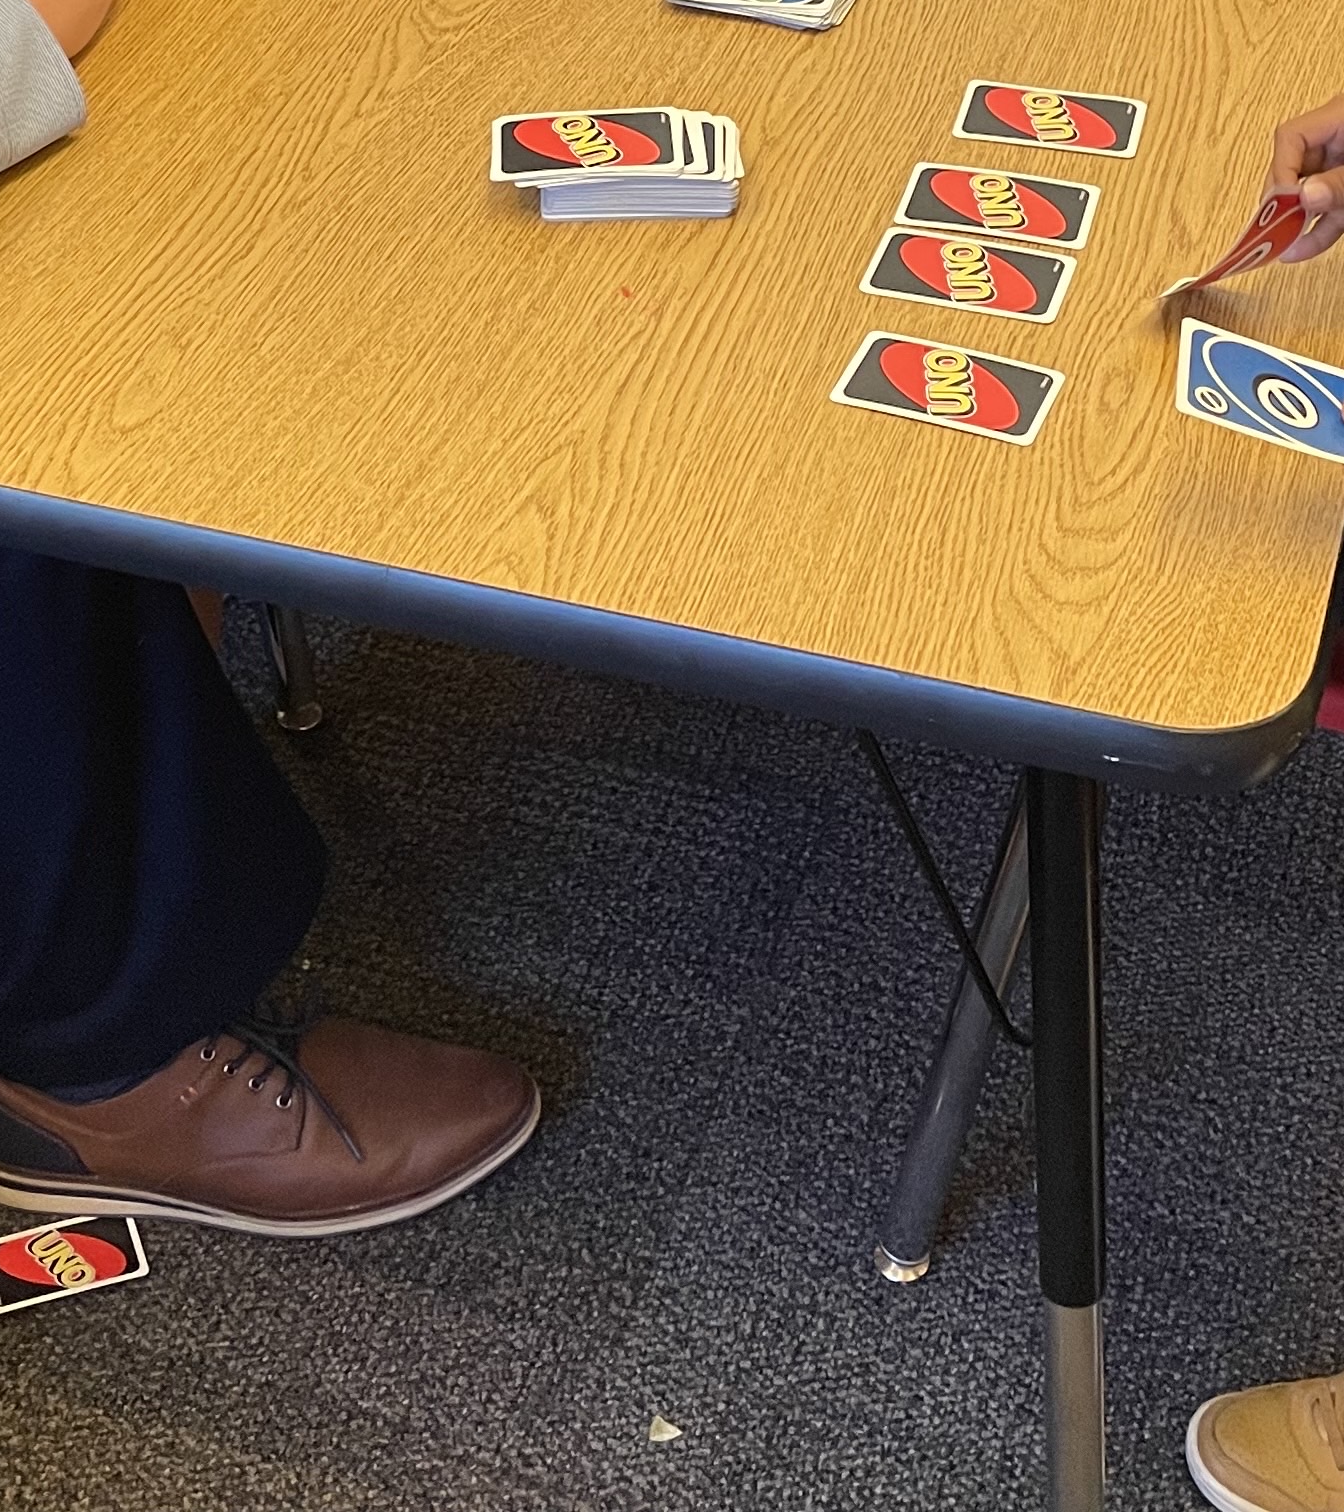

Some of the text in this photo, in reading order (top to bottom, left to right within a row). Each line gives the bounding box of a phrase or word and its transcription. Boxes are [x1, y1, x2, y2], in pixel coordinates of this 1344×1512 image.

[552, 115, 623, 168] UNO
[1022, 91, 1080, 144] UNO
[969, 172, 1026, 231] UNO
[941, 240, 997, 305] UNO
[923, 347, 977, 419] UNO
[25, 1229, 96, 1289] UNO
